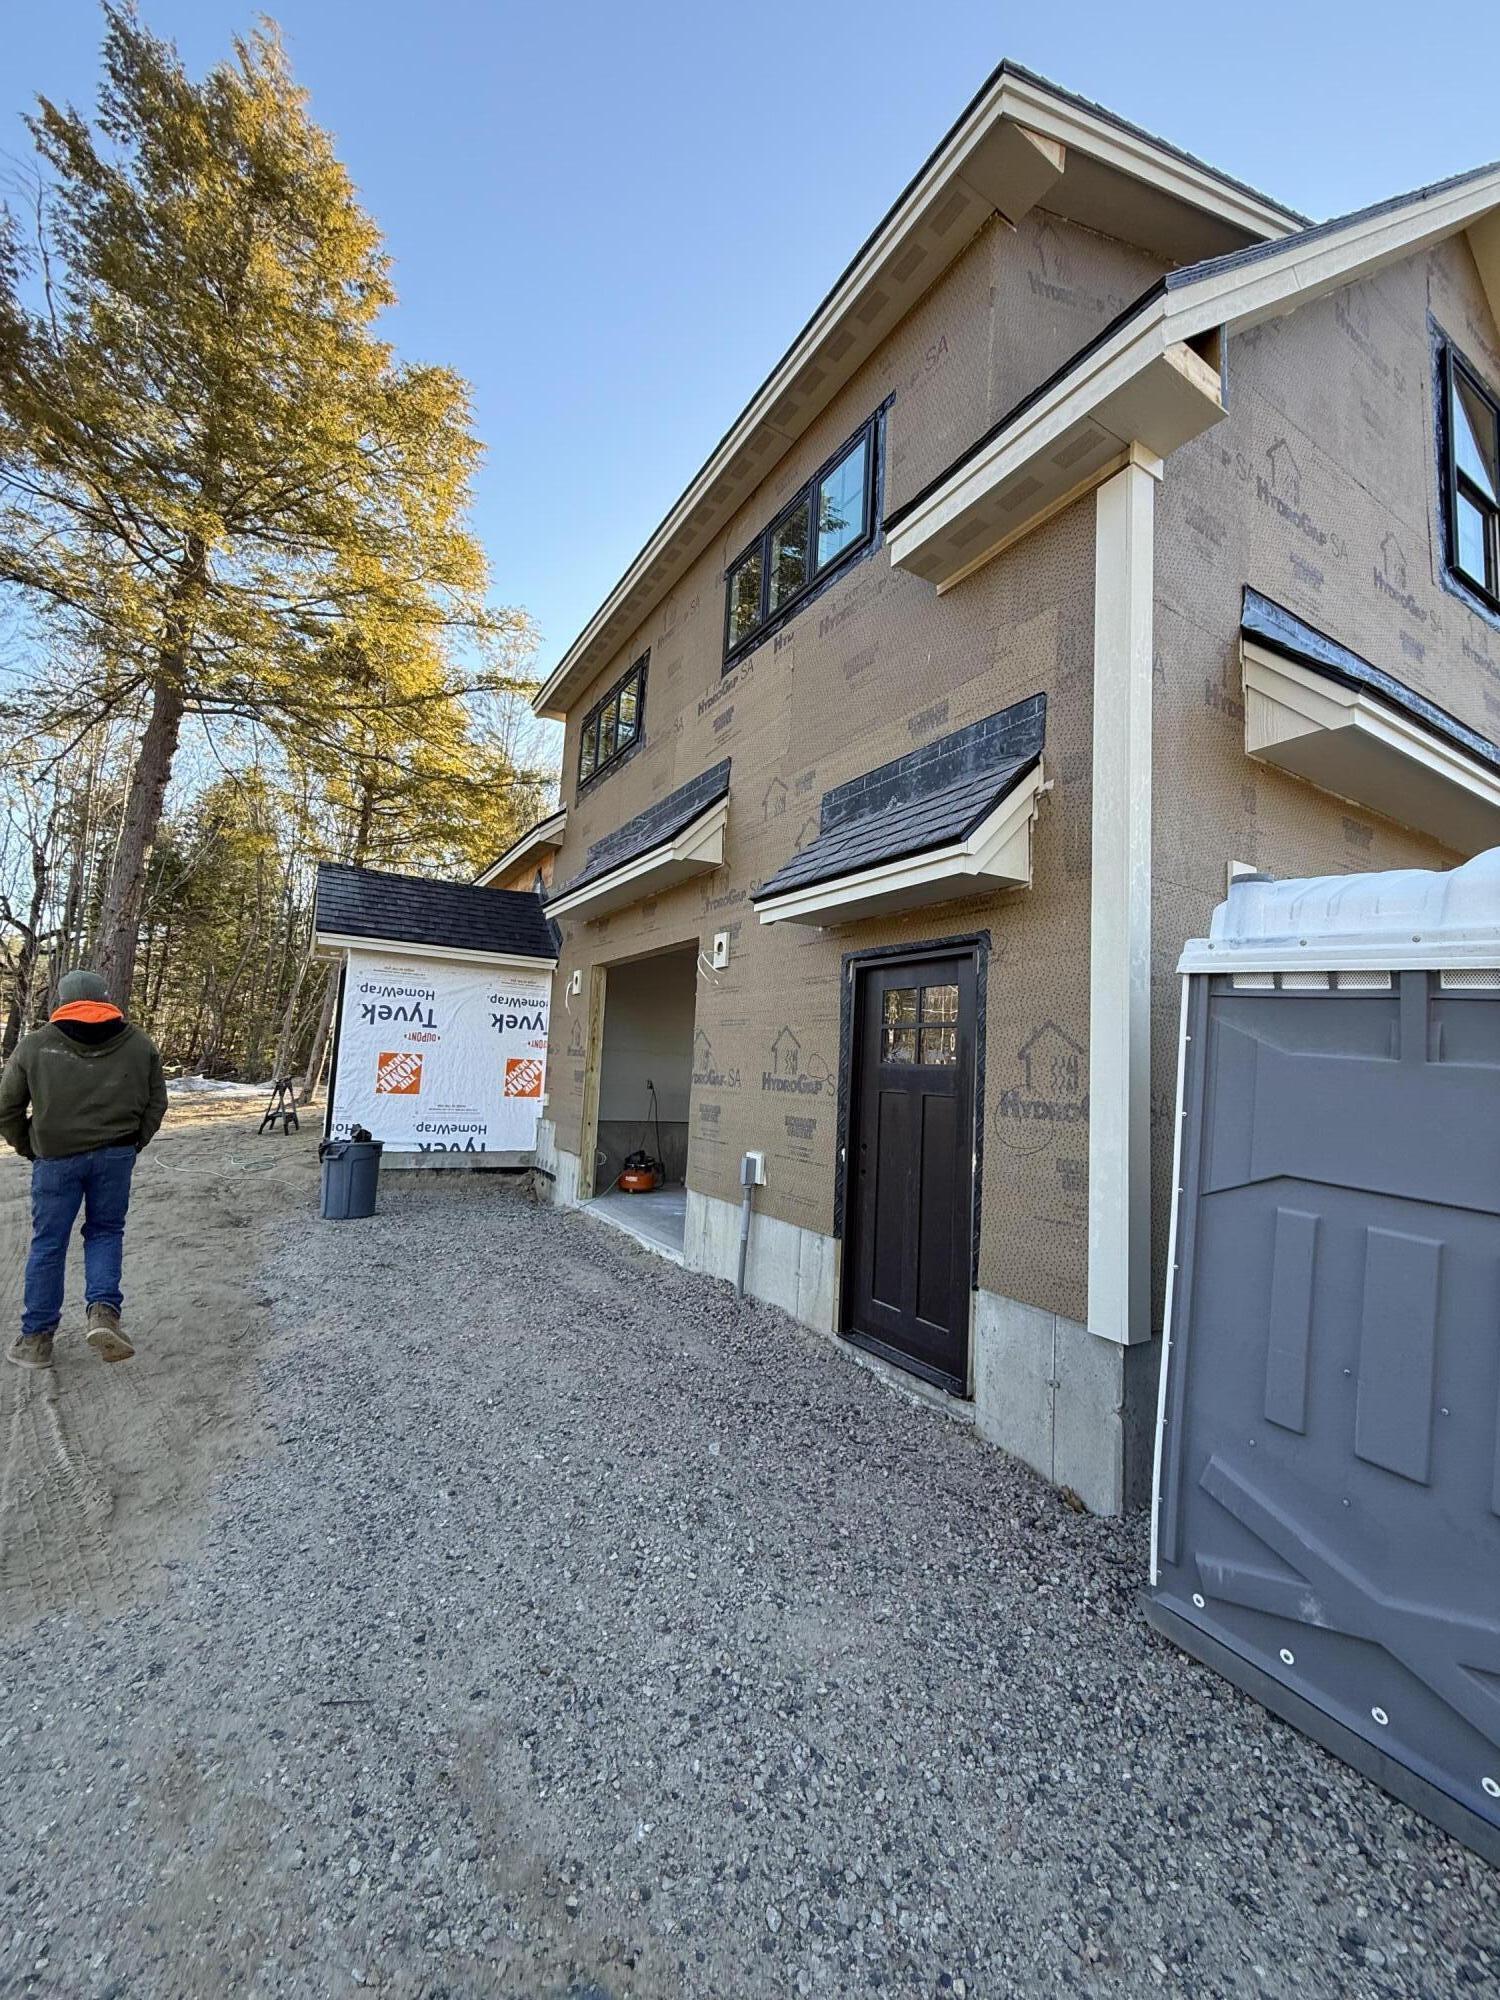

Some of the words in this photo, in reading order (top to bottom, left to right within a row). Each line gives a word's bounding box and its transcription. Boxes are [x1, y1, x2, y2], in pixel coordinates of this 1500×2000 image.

[360, 982, 436, 1001] HomeWrap
[490, 993, 549, 1009] omeWrap
[361, 1002, 438, 1029] Tyvek
[490, 1011, 548, 1036] yvek
[376, 1053, 422, 1094] HOME
[377, 1053, 407, 1080] DEPOT
[504, 1059, 543, 1097] HOME
[728, 1067, 741, 1088] SA
[397, 1073, 417, 1091] THE
[826, 1073, 836, 1097] S
[416, 1121, 487, 1135] HomeWrap
